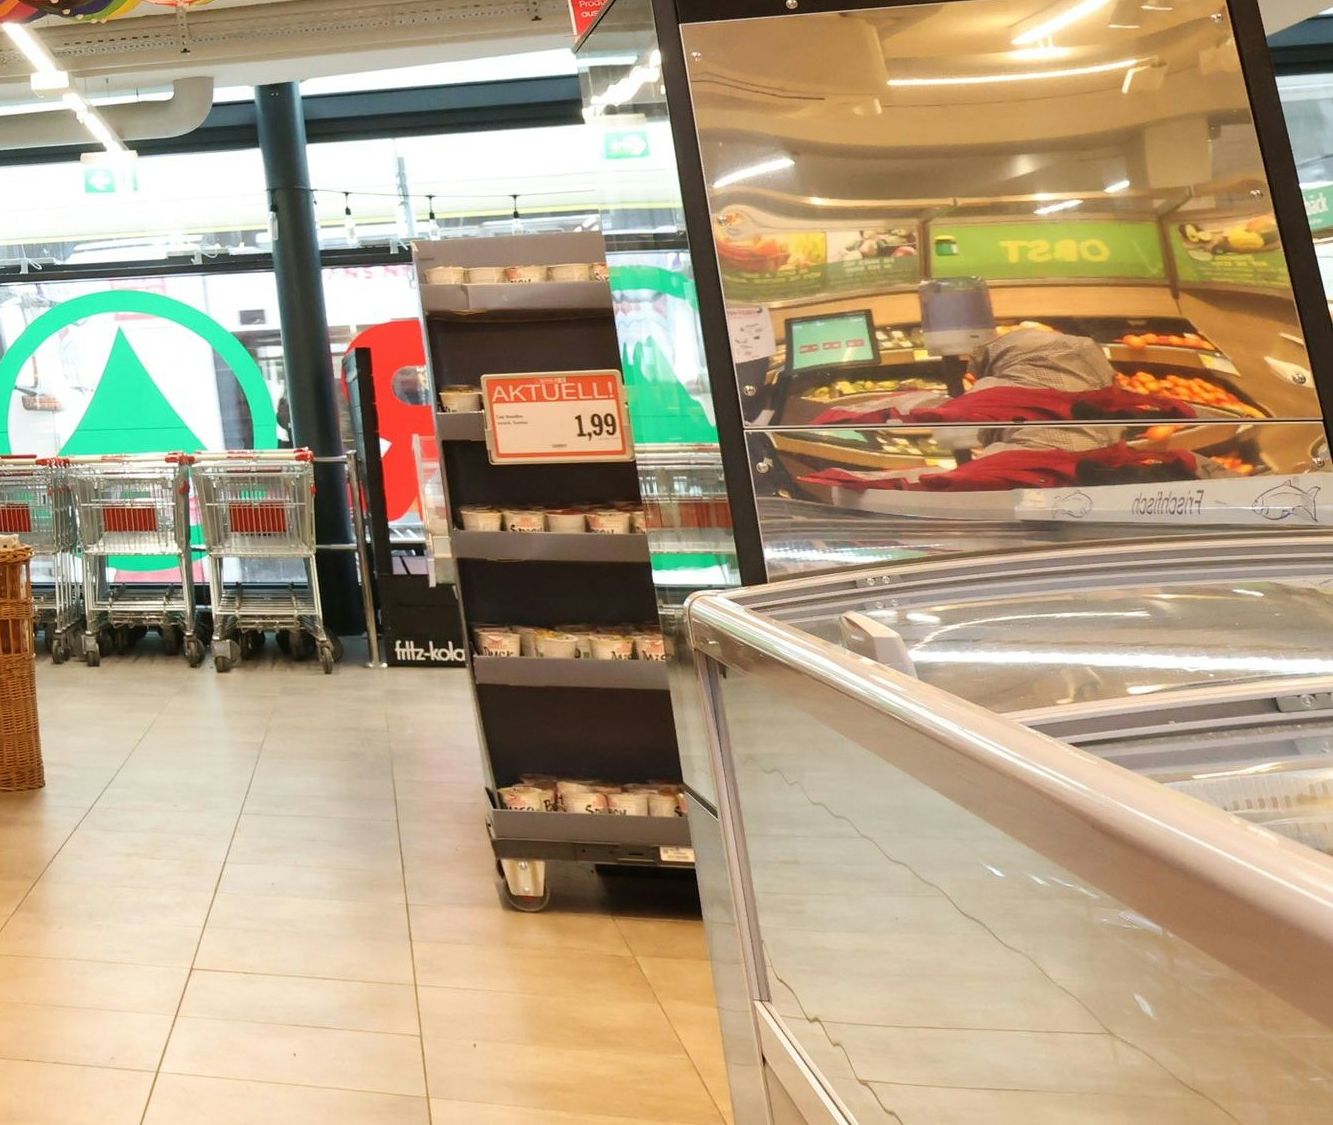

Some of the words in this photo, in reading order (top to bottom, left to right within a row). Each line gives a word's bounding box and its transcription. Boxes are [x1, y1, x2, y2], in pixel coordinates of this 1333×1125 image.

[492, 381, 614, 402] AKTUELL!
[574, 413, 617, 442] 1,99
[394, 639, 466, 662] fritz-kola
